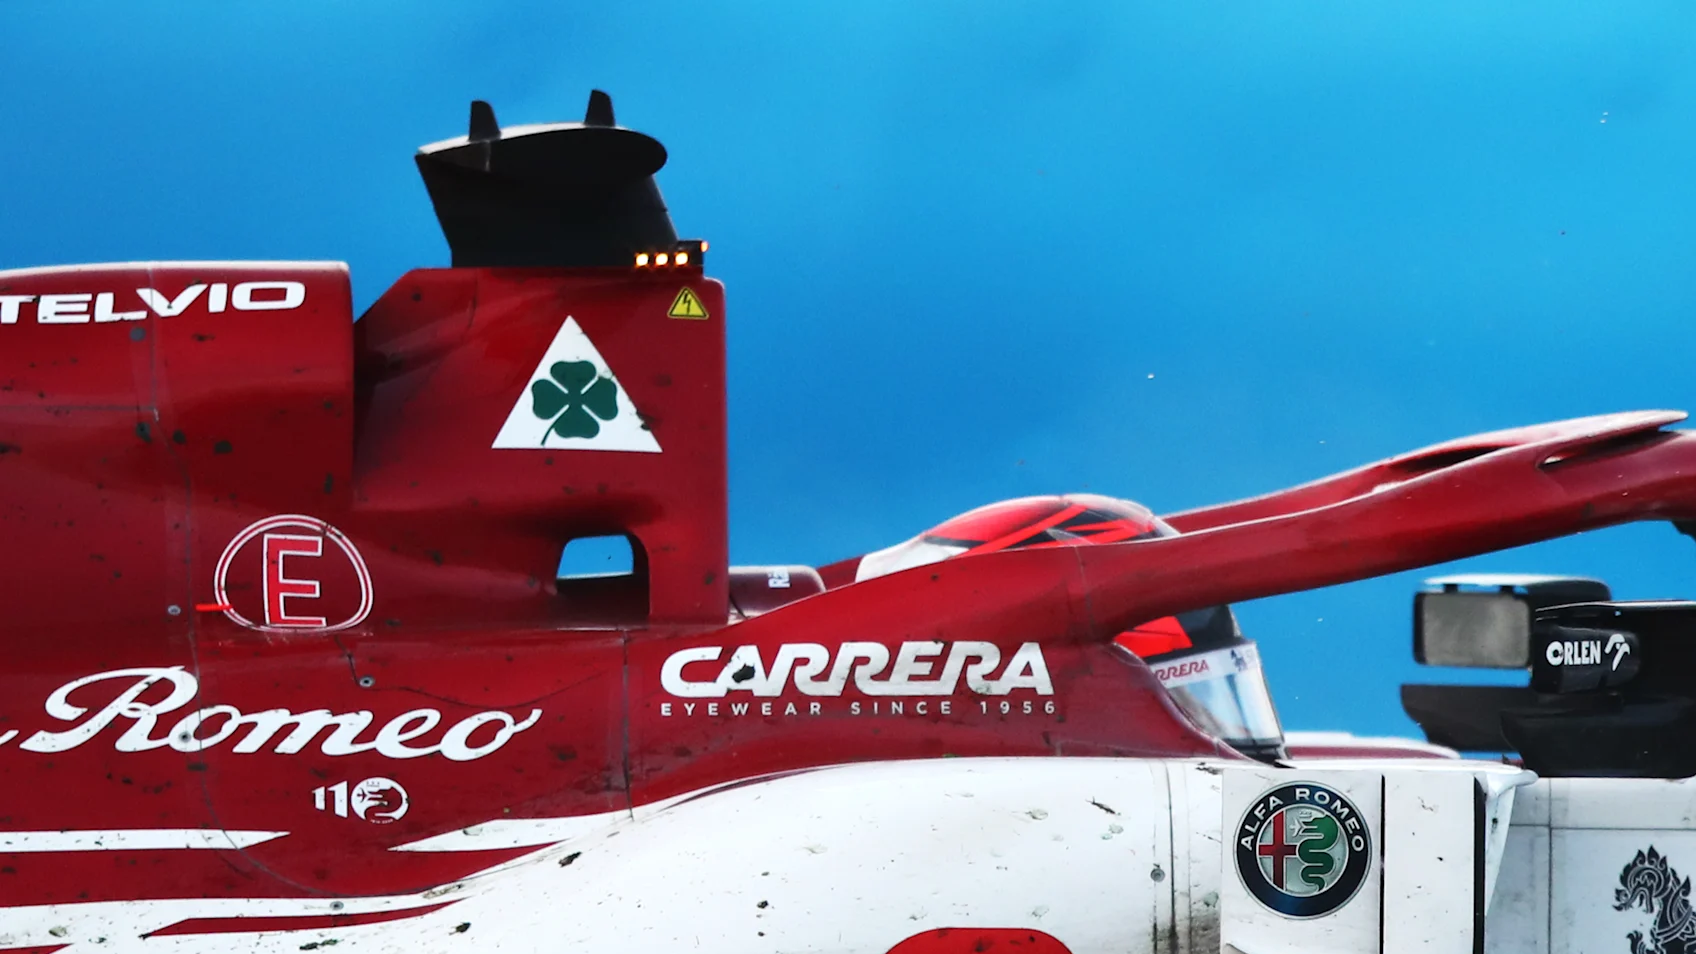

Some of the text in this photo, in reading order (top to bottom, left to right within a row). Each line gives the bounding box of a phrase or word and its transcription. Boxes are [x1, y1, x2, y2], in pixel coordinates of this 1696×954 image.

[661, 641, 1054, 697] CARRERA
[1546, 641, 1601, 666] ORLEN
[19, 666, 542, 760] Romeo
[661, 701, 1055, 716] EYEWEAR SINCE 1956
[1240, 788, 1364, 852] ALFA ROMEO
